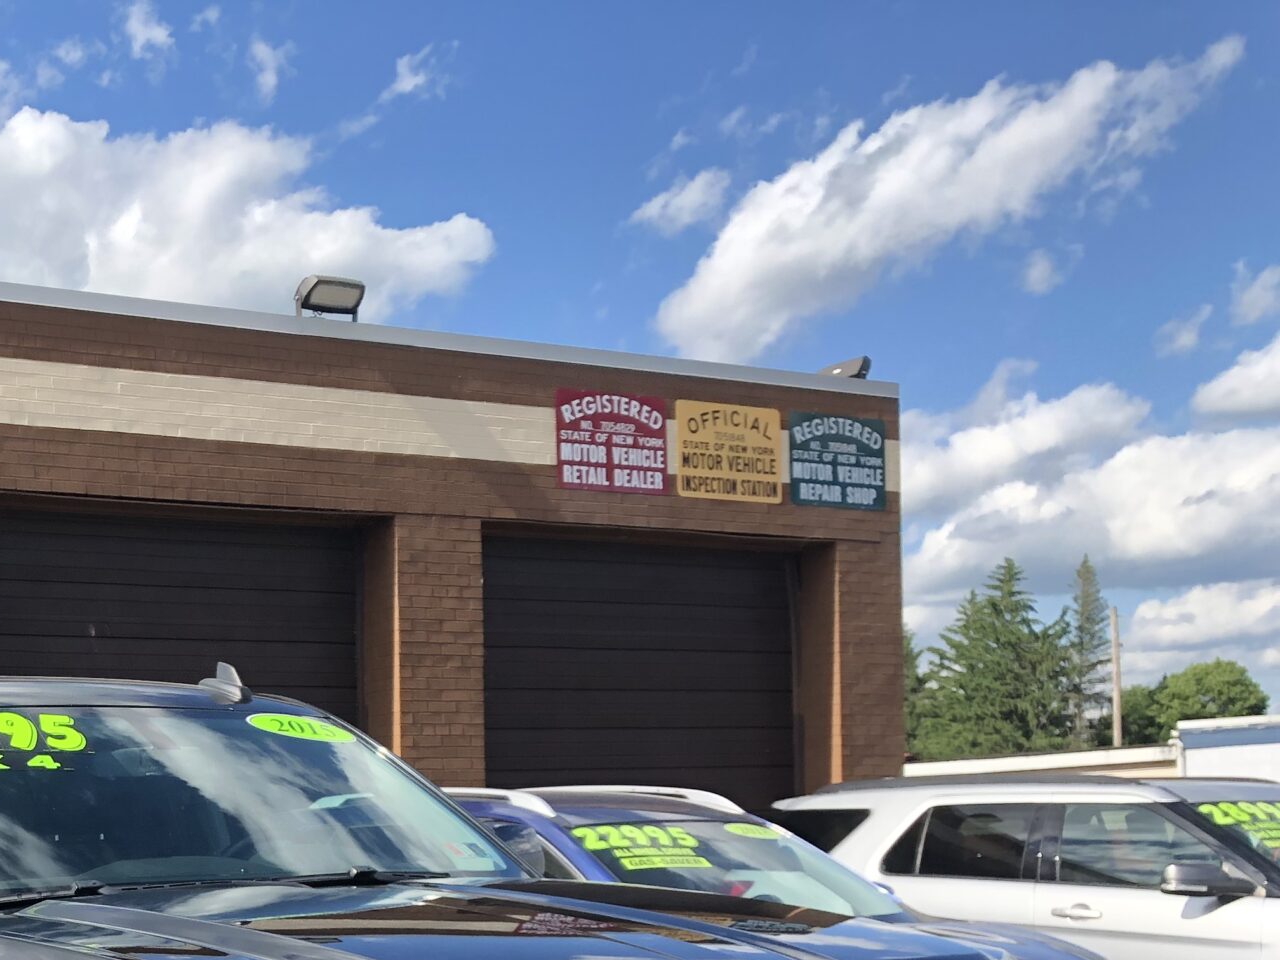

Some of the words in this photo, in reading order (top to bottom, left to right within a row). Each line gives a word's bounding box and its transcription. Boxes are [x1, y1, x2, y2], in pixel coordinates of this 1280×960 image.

[561, 395, 663, 430] REGISTERED
[687, 409, 773, 441] OFFICIAL
[792, 417, 882, 449] REGISTERED
[560, 430, 592, 441] STATE
[595, 432, 609, 442] OF
[612, 434, 635, 445] NEW
[637, 436, 665, 448] YORK
[682, 440, 710, 451] STATE
[713, 442, 726, 452] OF
[728, 444, 749, 454] NEW
[751, 446, 775, 457] YORK
[560, 442, 607, 464] MOTOR
[612, 446, 665, 469] VEHICLE
[682, 451, 723, 471] MOTOR
[727, 455, 777, 475] VEHICLE
[792, 449, 821, 461] STATE
[822, 452, 835, 462] OF
[837, 454, 857, 465] NEW
[858, 456, 883, 467] YORK
[562, 464, 610, 486] RETAIL
[613, 468, 664, 490] DEALER
[792, 461, 834, 481] MOTOR
[837, 465, 883, 486] VEHICLE
[682, 474, 738, 495] INSPECTION
[741, 479, 778, 498] STATION
[800, 482, 842, 503] REPAIR
[846, 485, 877, 505] SHOP
[269, 718, 337, 738] 2015
[26, 754, 62, 770] 4
[1198, 801, 1280, 825] 2899
[571, 824, 700, 850] 22995
